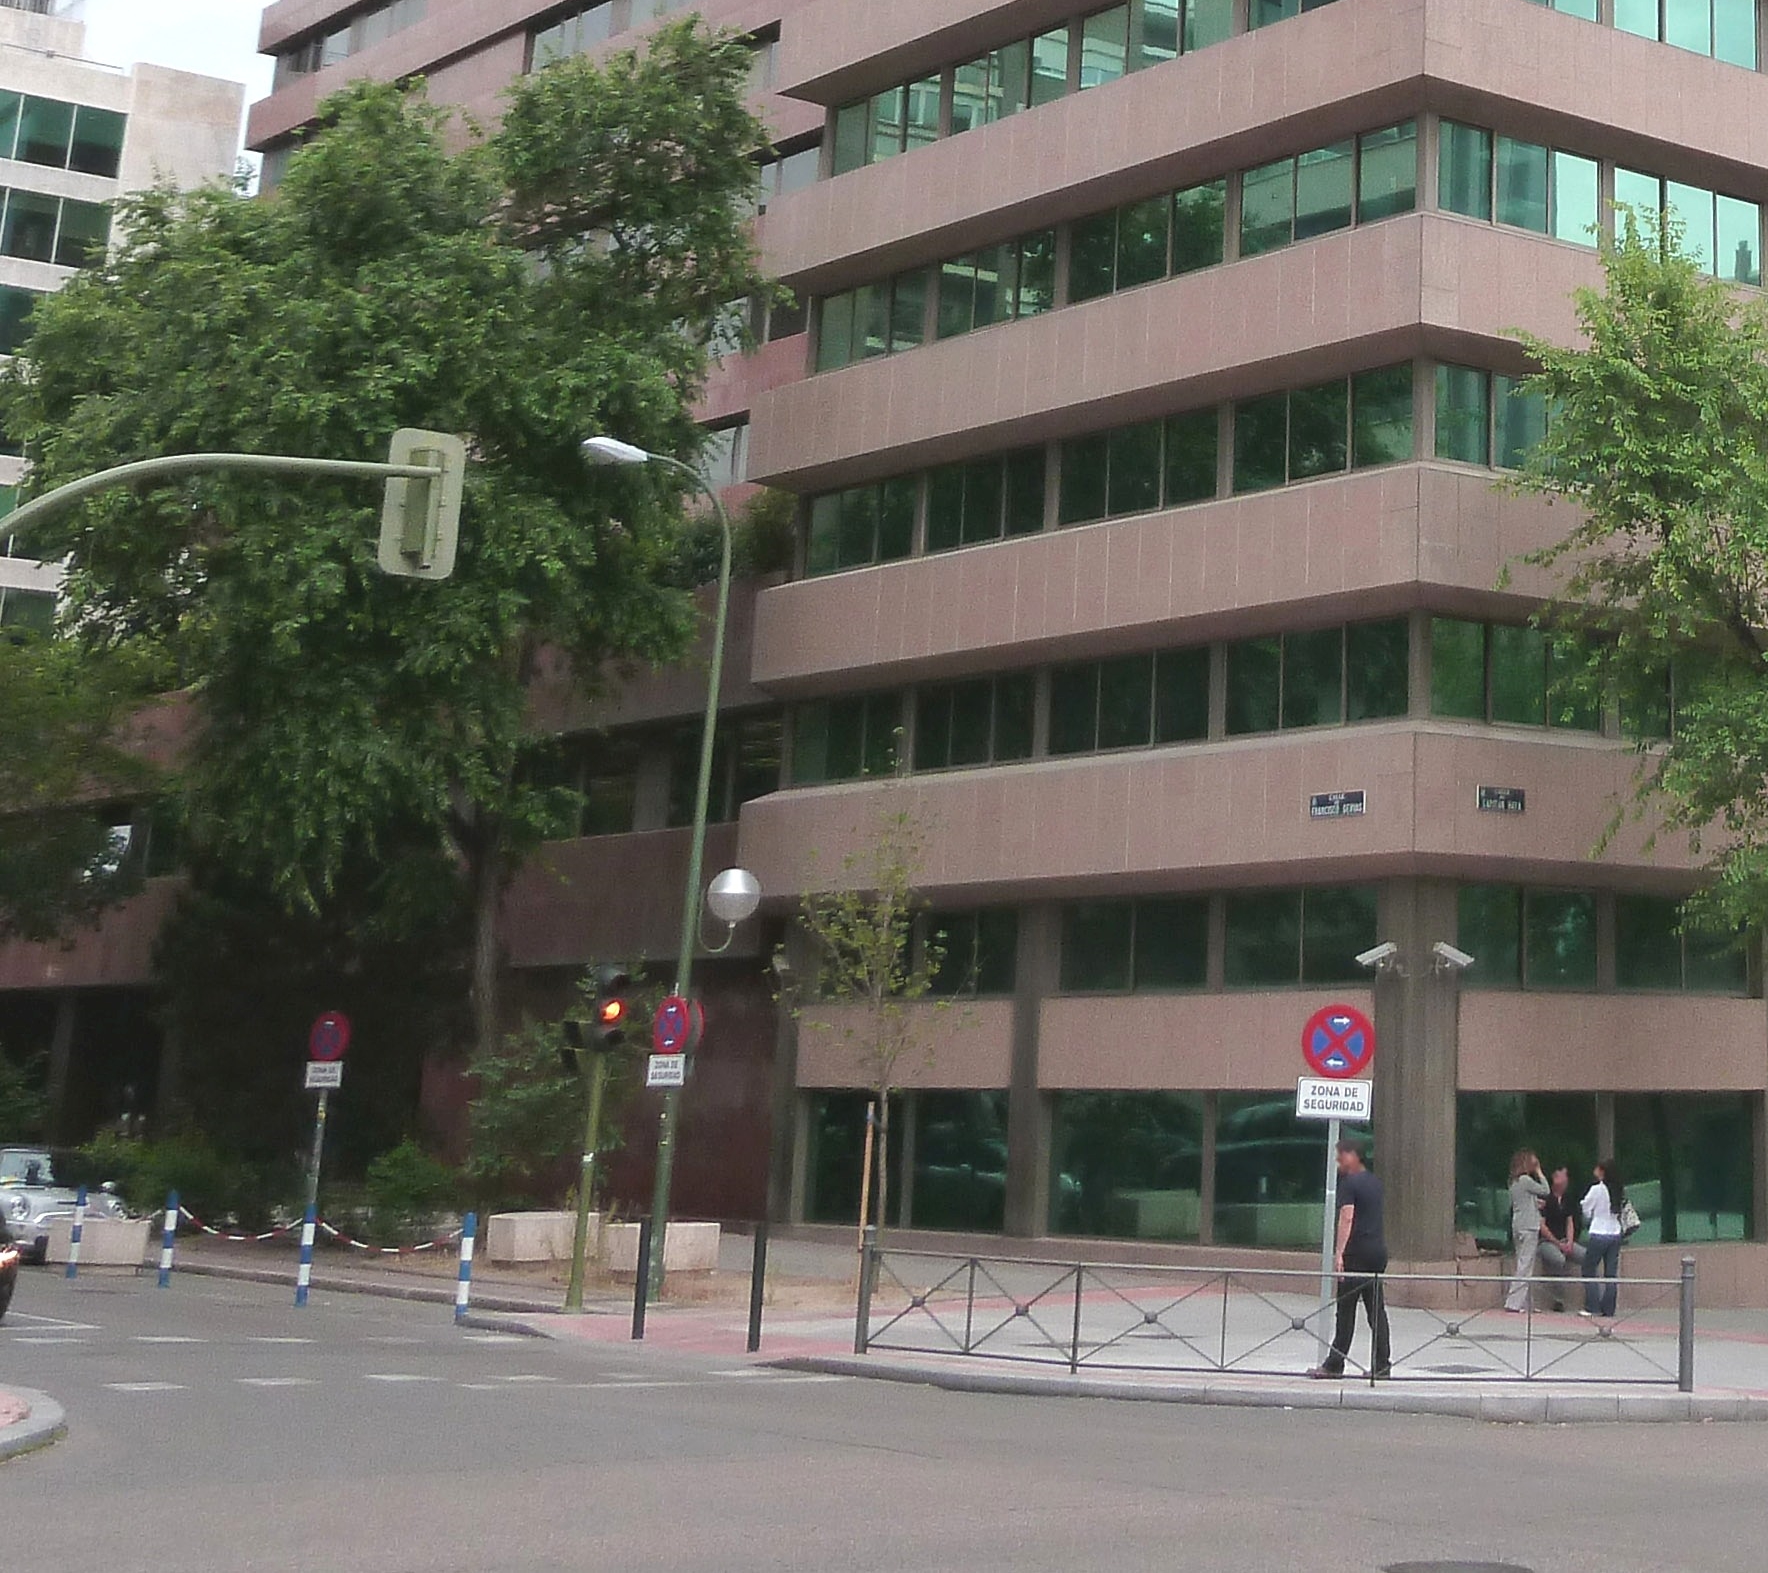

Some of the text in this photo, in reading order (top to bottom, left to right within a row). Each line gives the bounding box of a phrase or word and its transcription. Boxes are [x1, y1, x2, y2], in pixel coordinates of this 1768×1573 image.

[1311, 1085, 1359, 1098] ZONA DE
[1303, 1098, 1364, 1112] SEGURIDAD
